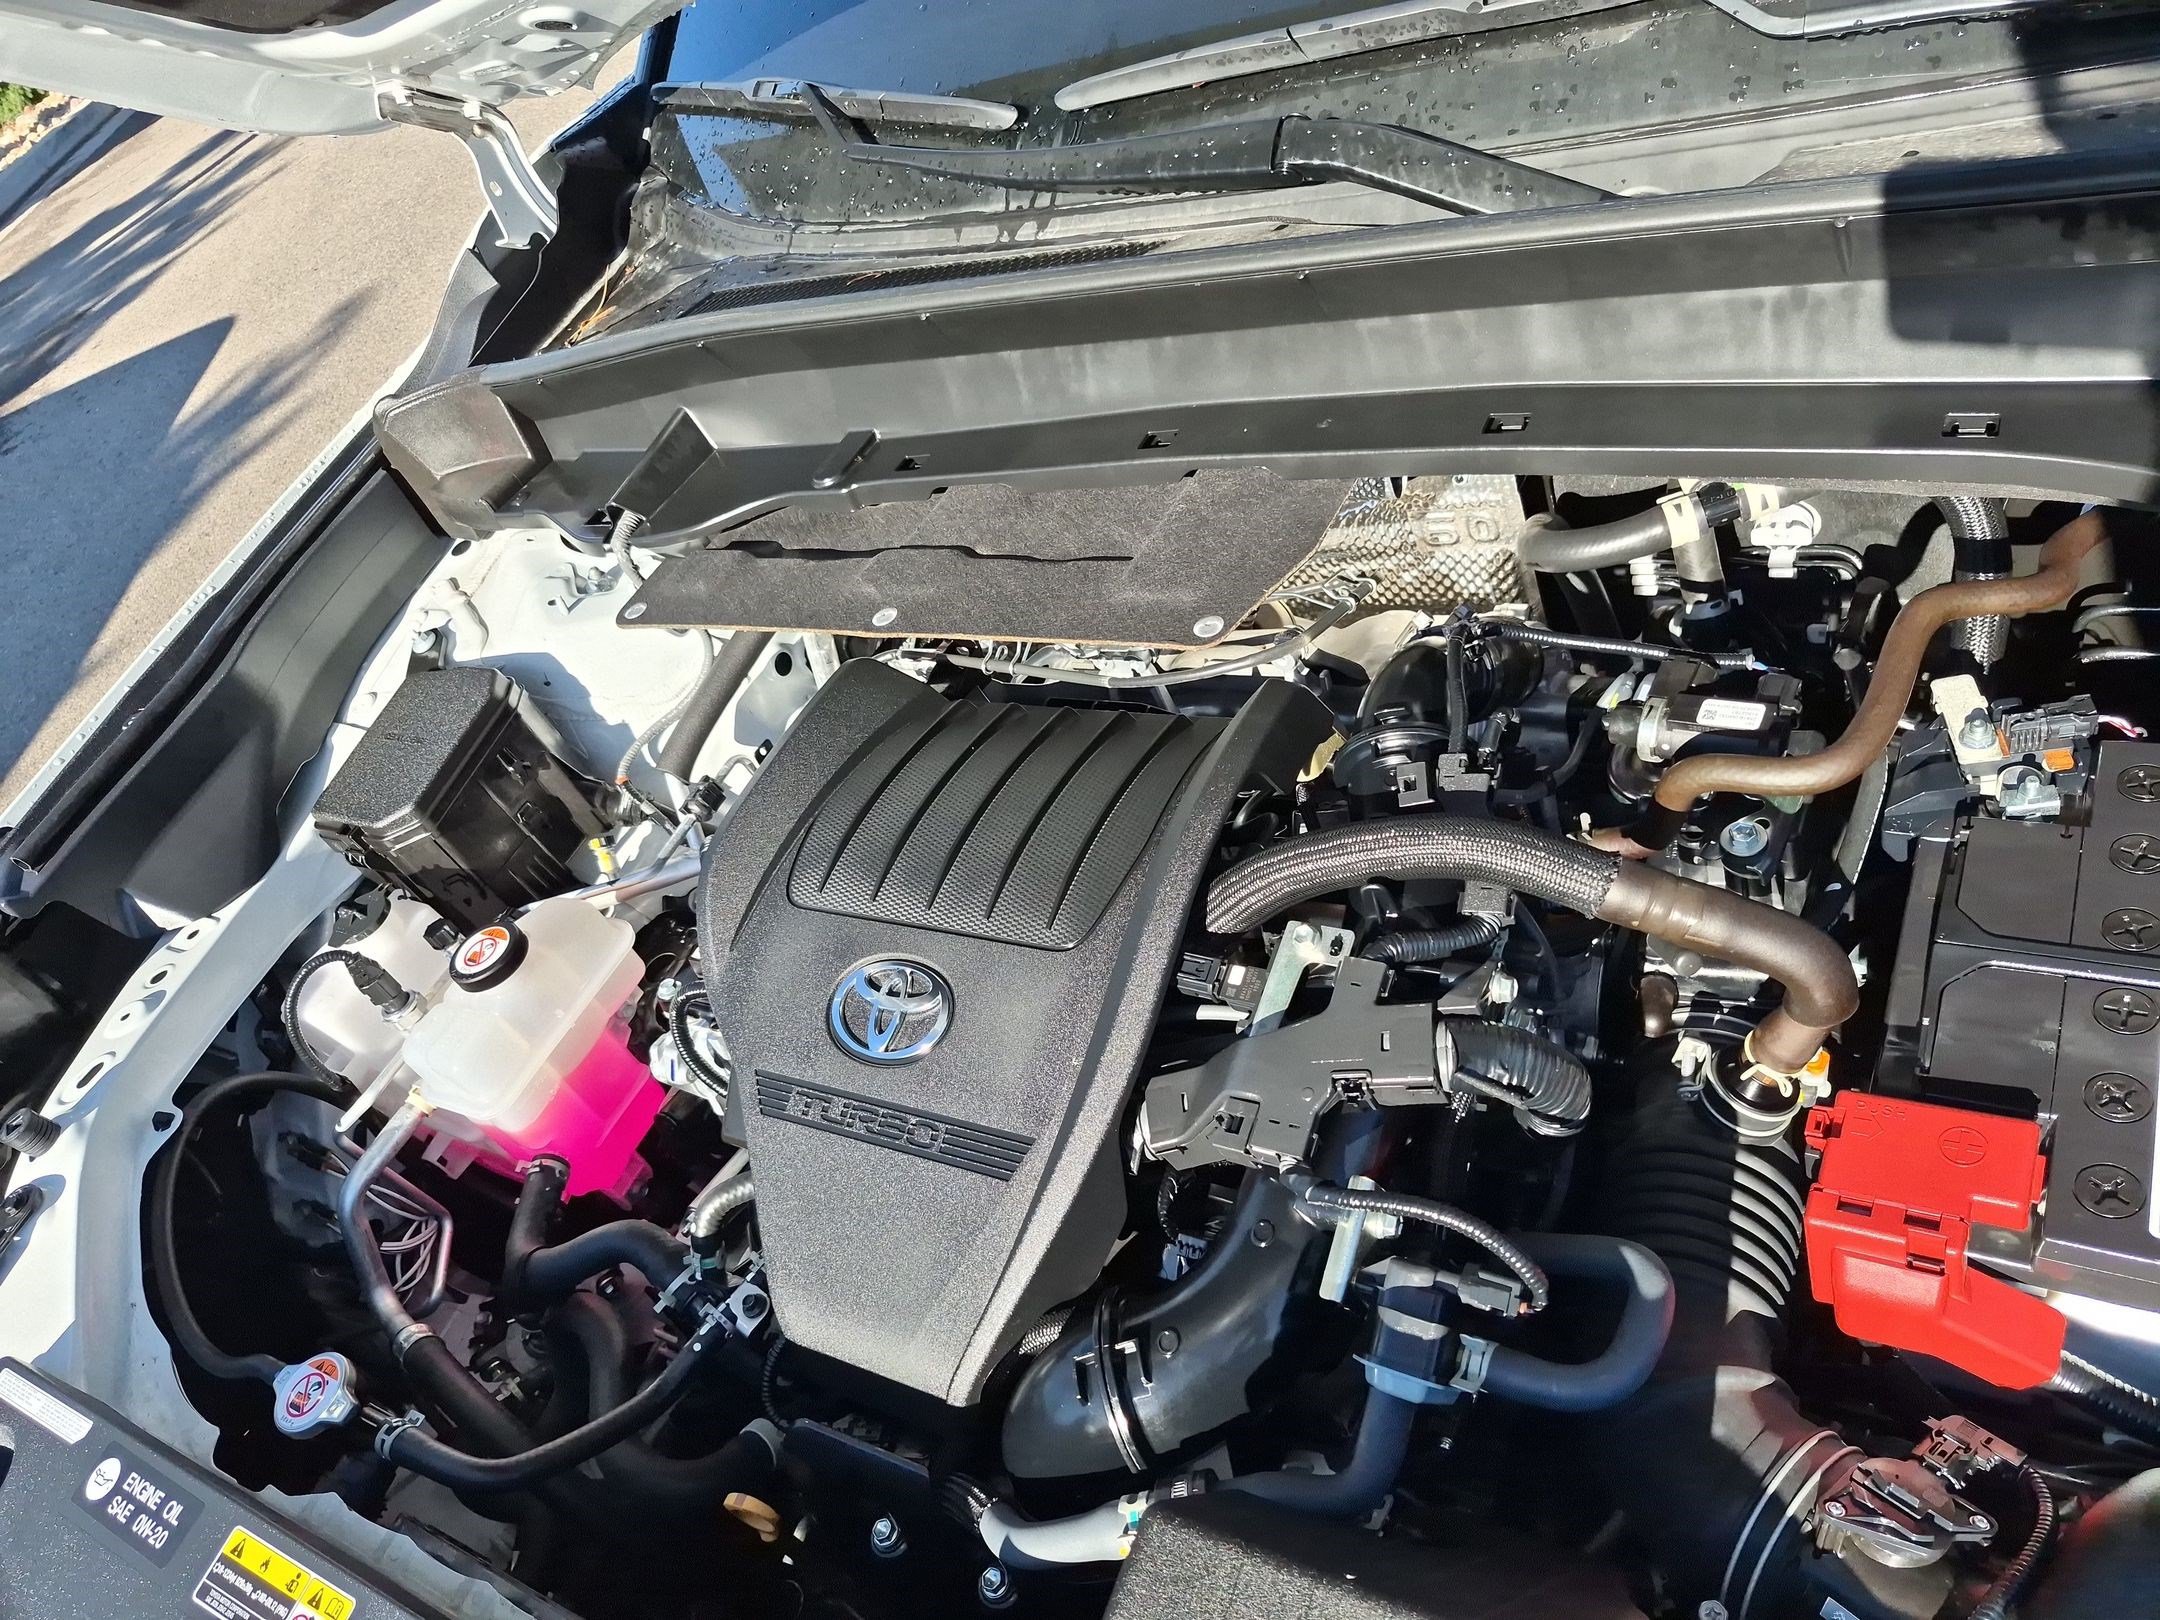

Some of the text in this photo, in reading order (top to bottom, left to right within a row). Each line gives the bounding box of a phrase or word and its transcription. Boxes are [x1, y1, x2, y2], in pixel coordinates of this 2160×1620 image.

[795, 1088, 942, 1149] TURBO
[1855, 1099, 1907, 1121] PUSH
[107, 1495, 169, 1549] SAE 0W-20
[122, 1471, 184, 1527] ENGINE OIL
